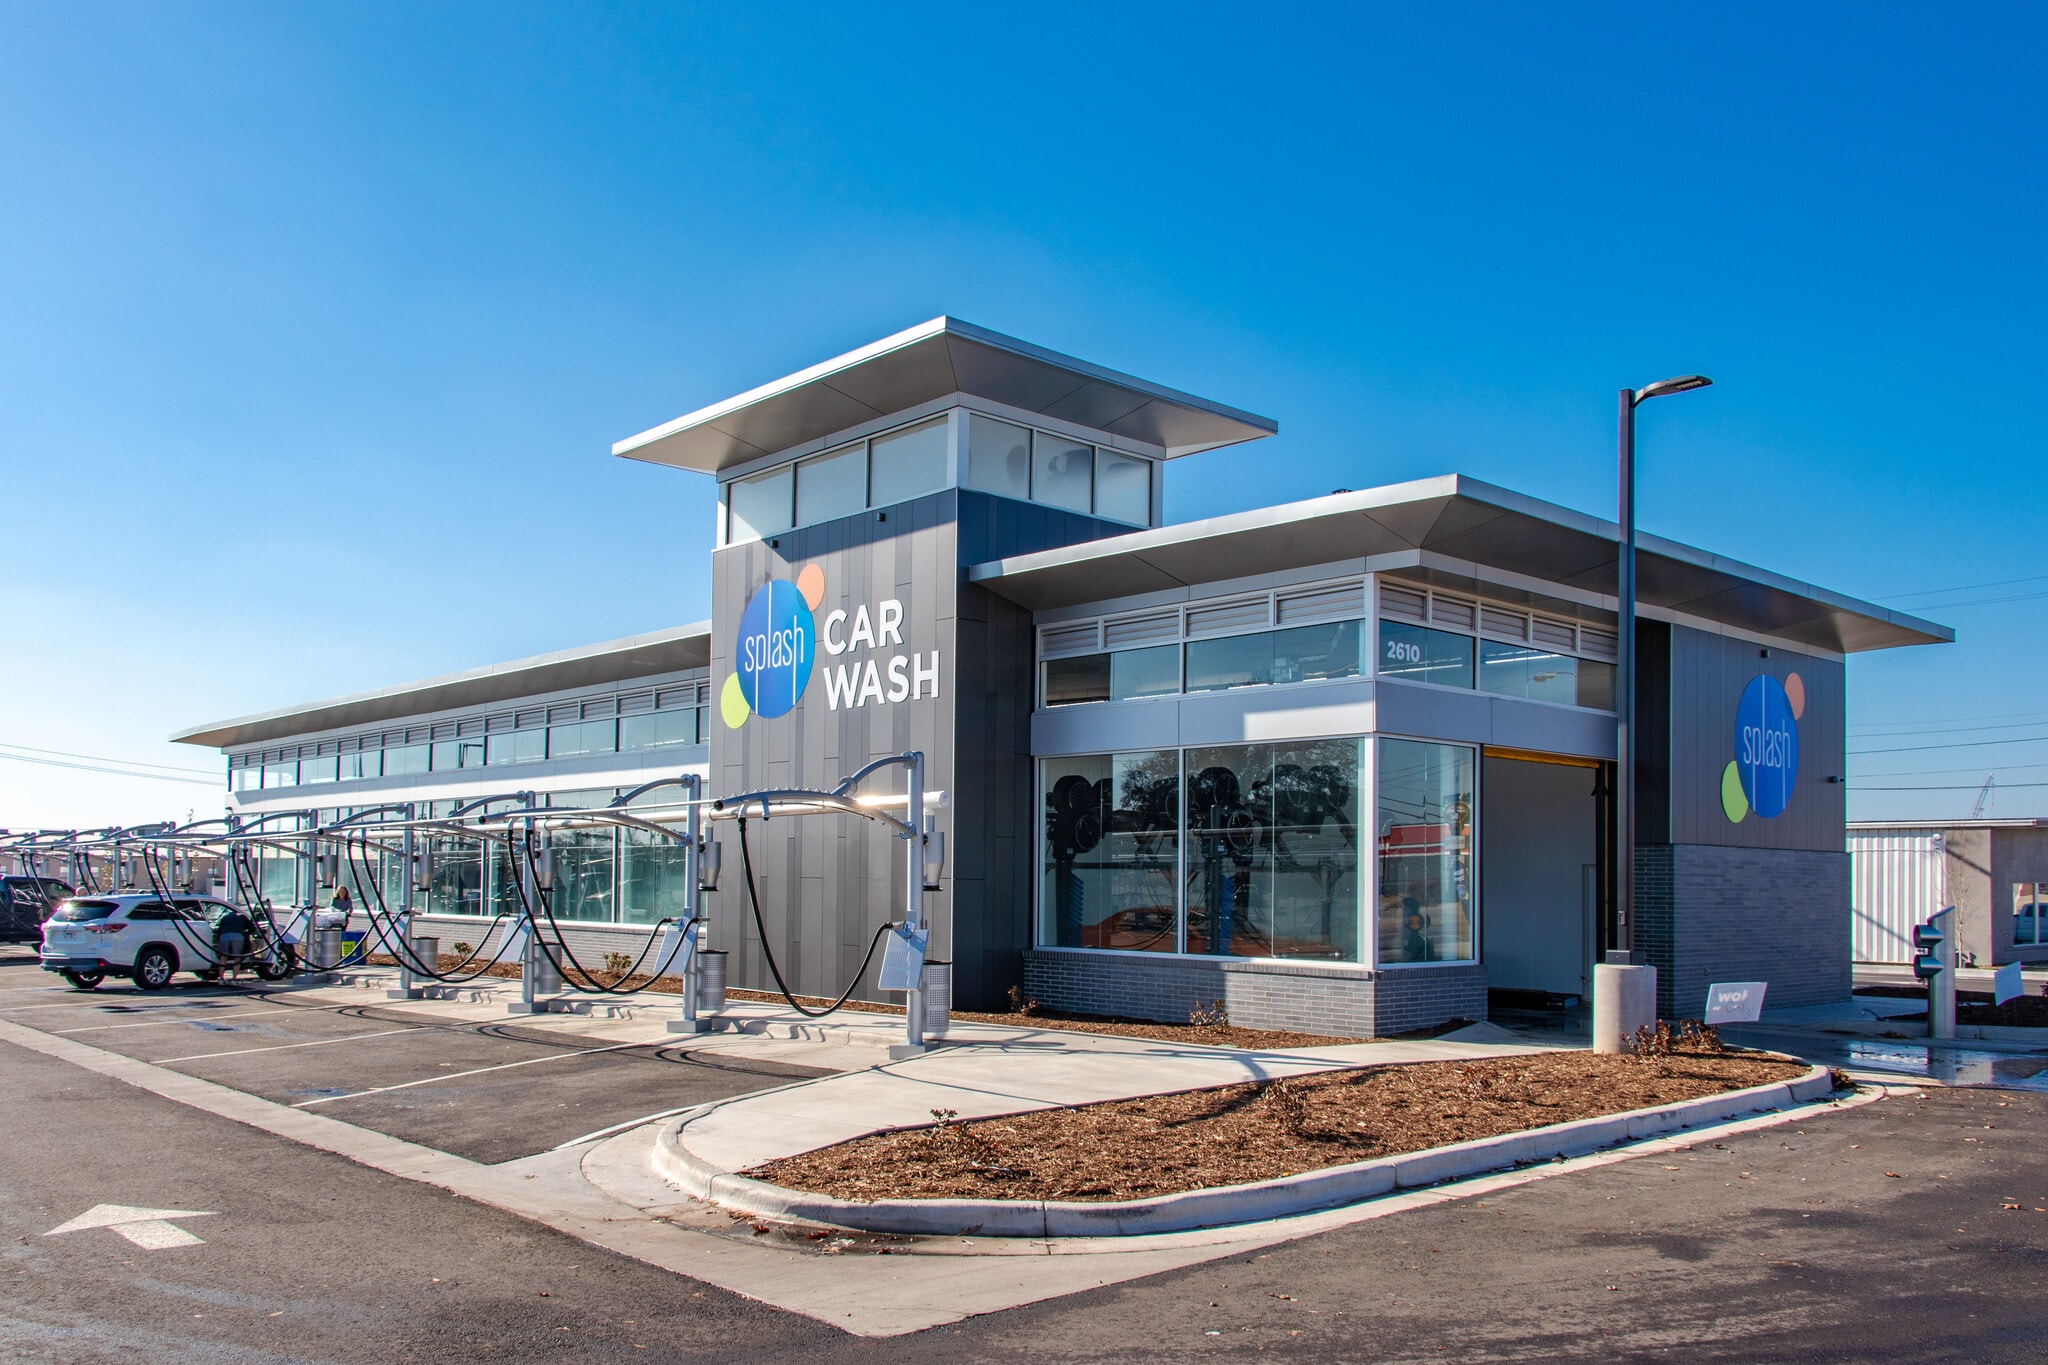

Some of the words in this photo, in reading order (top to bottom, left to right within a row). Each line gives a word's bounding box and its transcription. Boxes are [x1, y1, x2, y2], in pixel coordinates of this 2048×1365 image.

[823, 599, 904, 656] CAR
[1387, 640, 1420, 663] 2610
[823, 650, 940, 711] WASH
